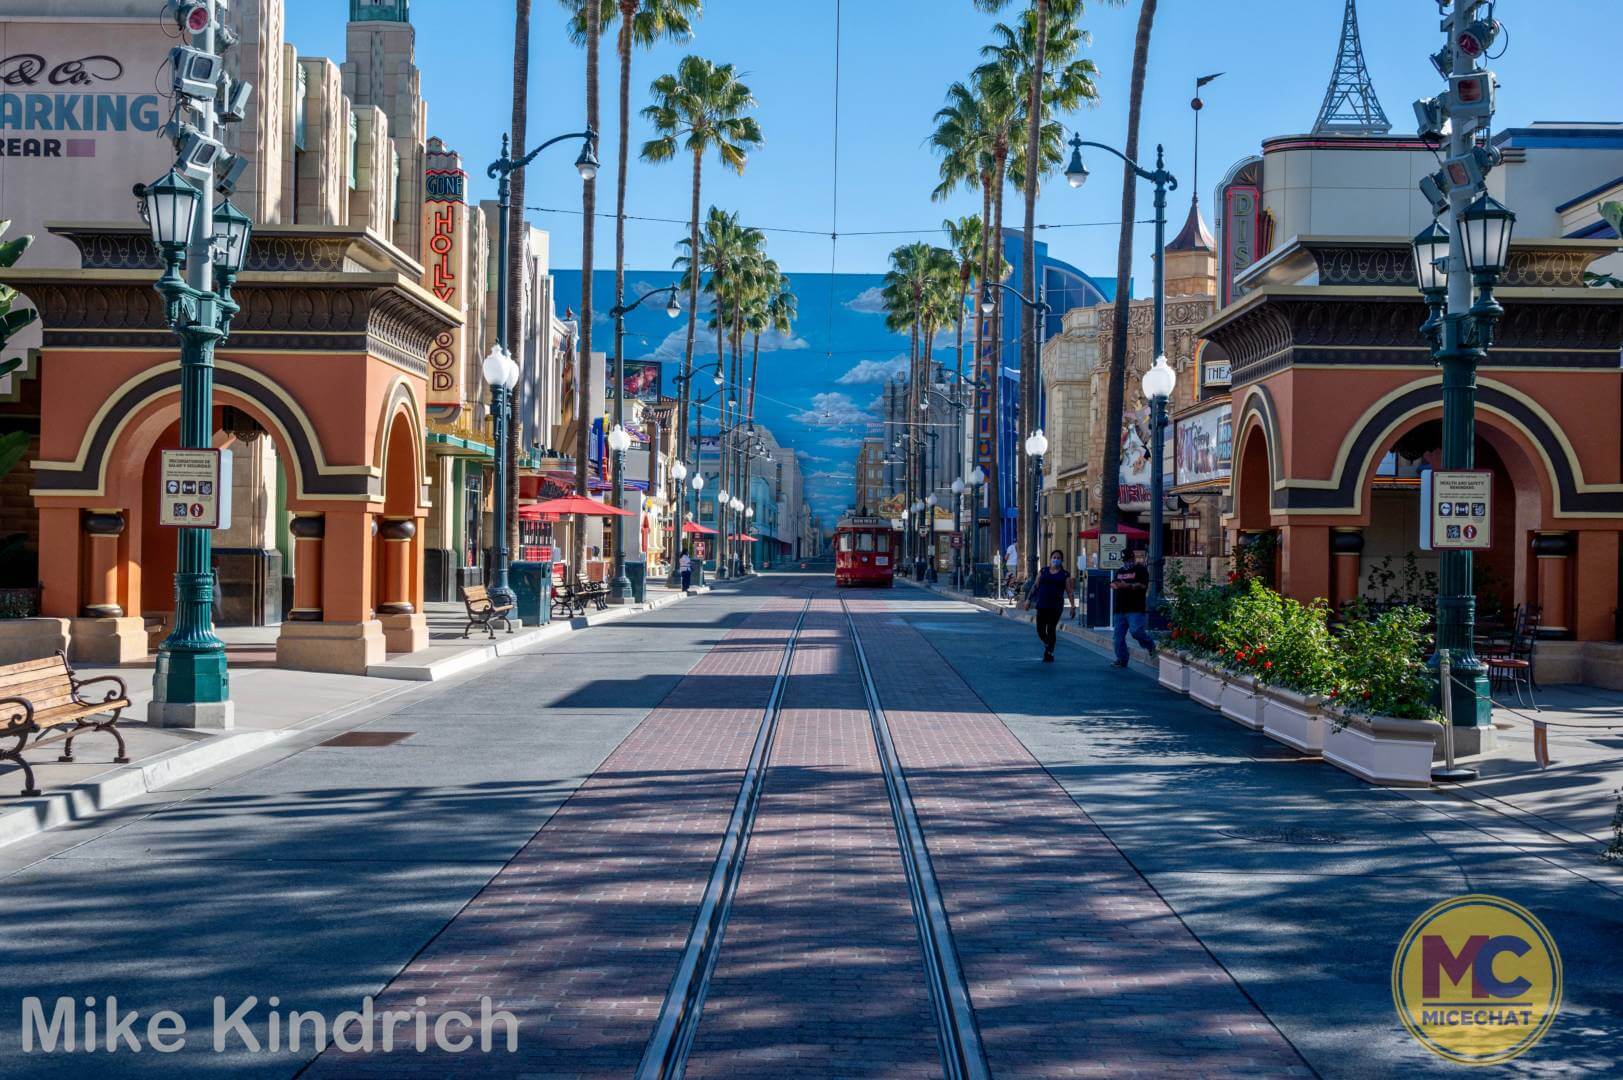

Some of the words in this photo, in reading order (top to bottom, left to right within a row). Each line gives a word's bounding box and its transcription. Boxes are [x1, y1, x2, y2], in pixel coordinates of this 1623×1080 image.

[48, 55, 123, 85] Co.
[0, 138, 61, 157] EAR
[430, 205, 455, 391] HOLLYOOD
